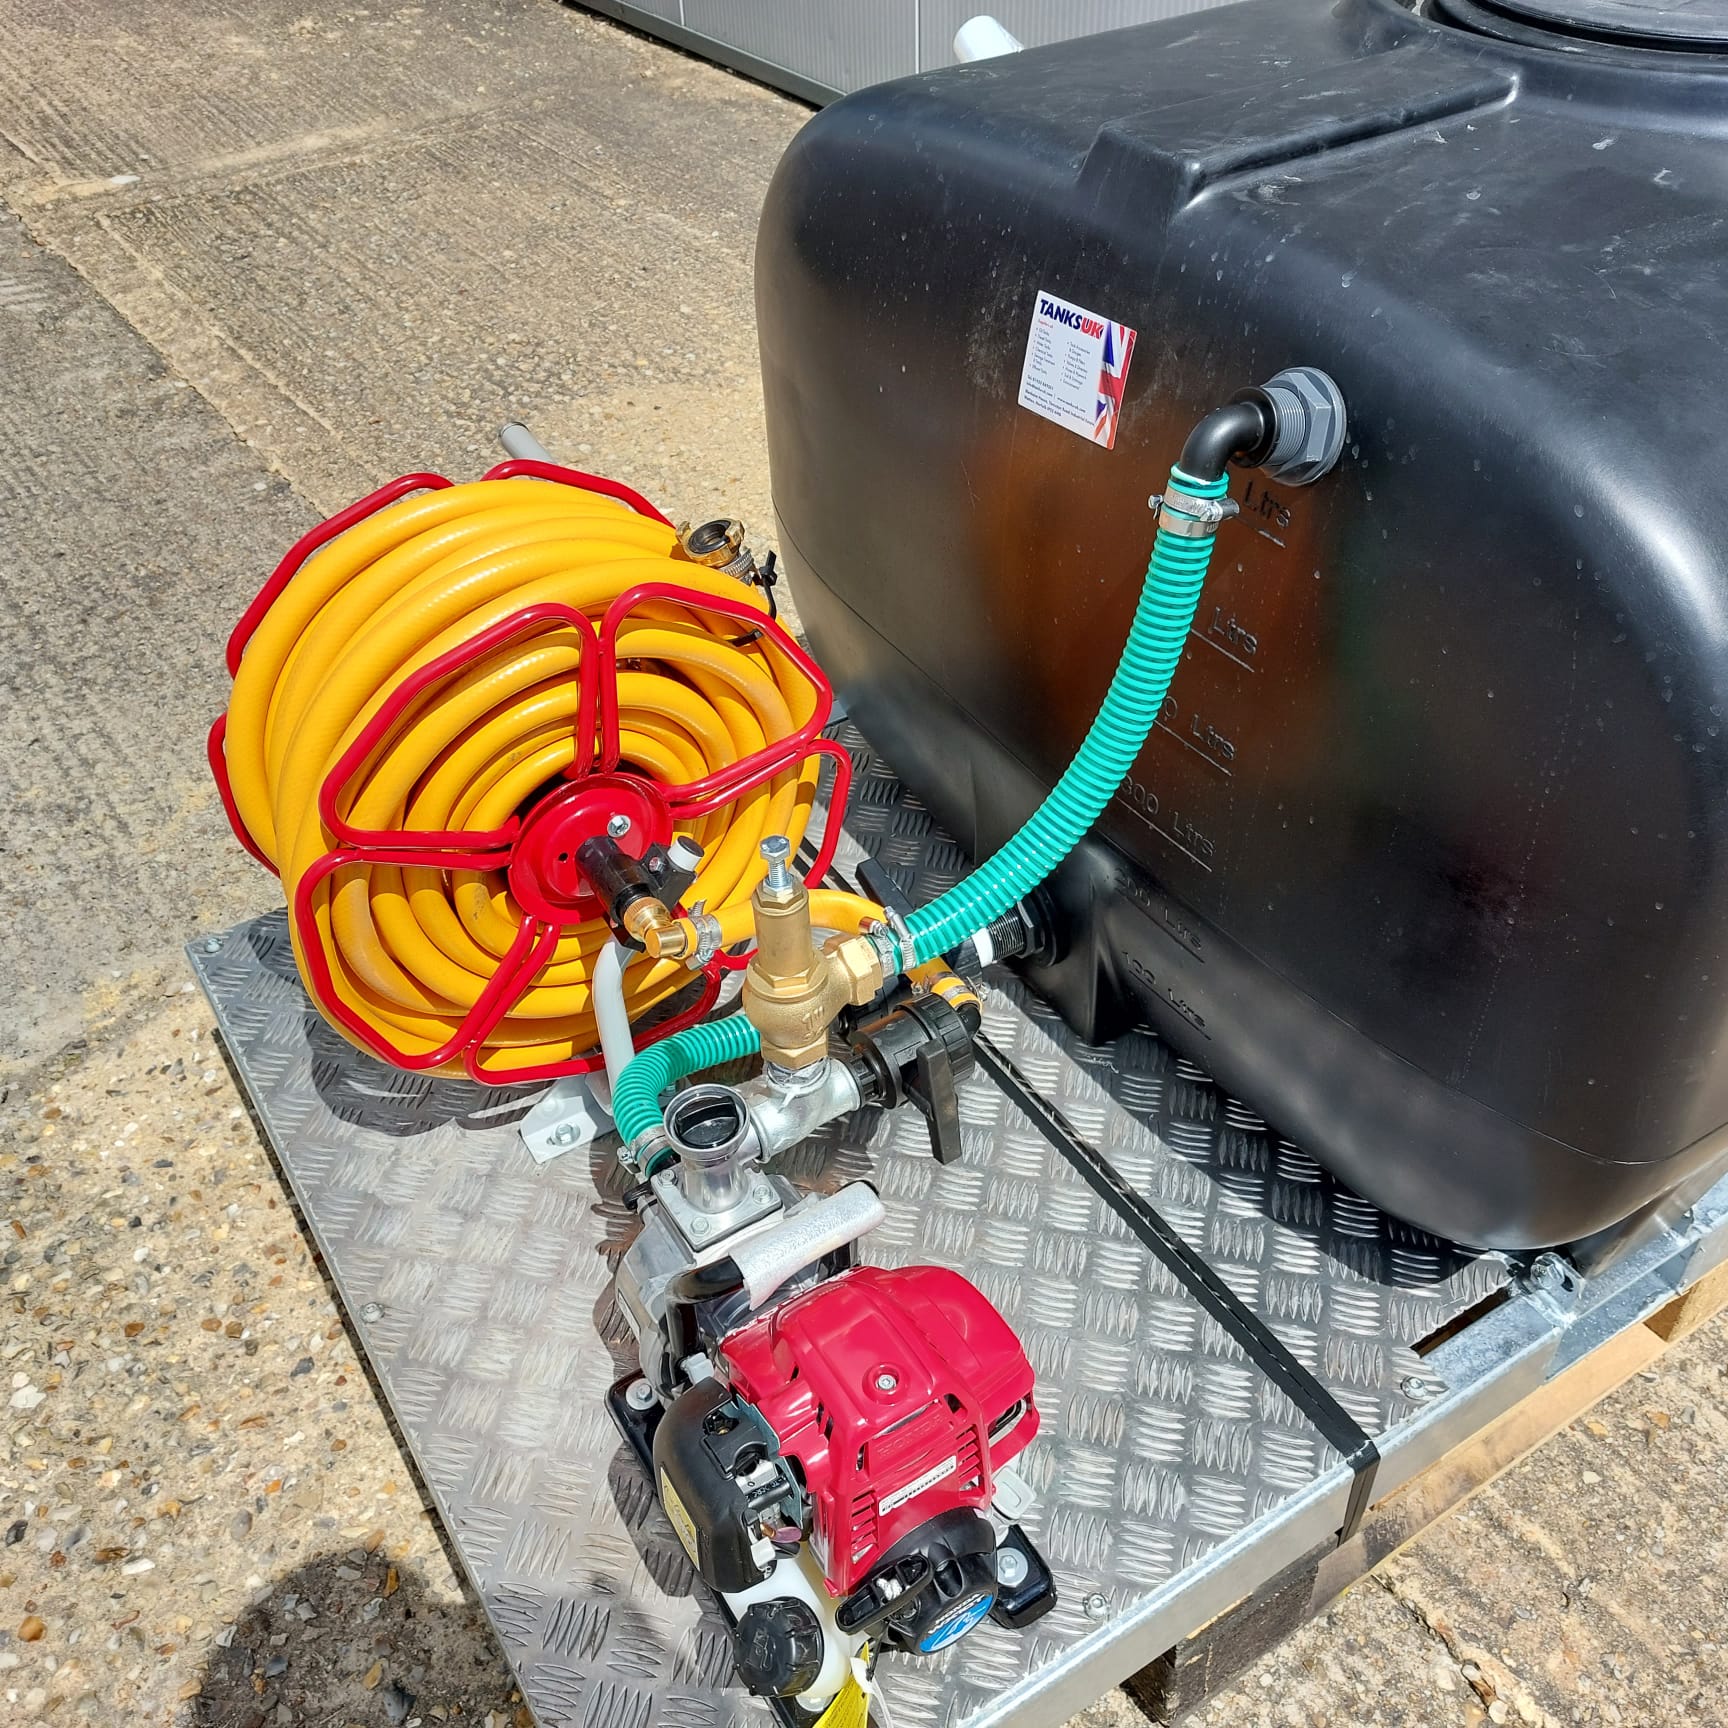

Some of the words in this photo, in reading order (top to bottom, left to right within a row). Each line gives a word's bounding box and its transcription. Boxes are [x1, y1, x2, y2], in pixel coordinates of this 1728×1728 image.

[1245, 480, 1291, 529] Ltrs
[1213, 605, 1258, 655] Ltrs
[1190, 712, 1236, 761] Ltrs
[1173, 810, 1217, 858] Ltrs
